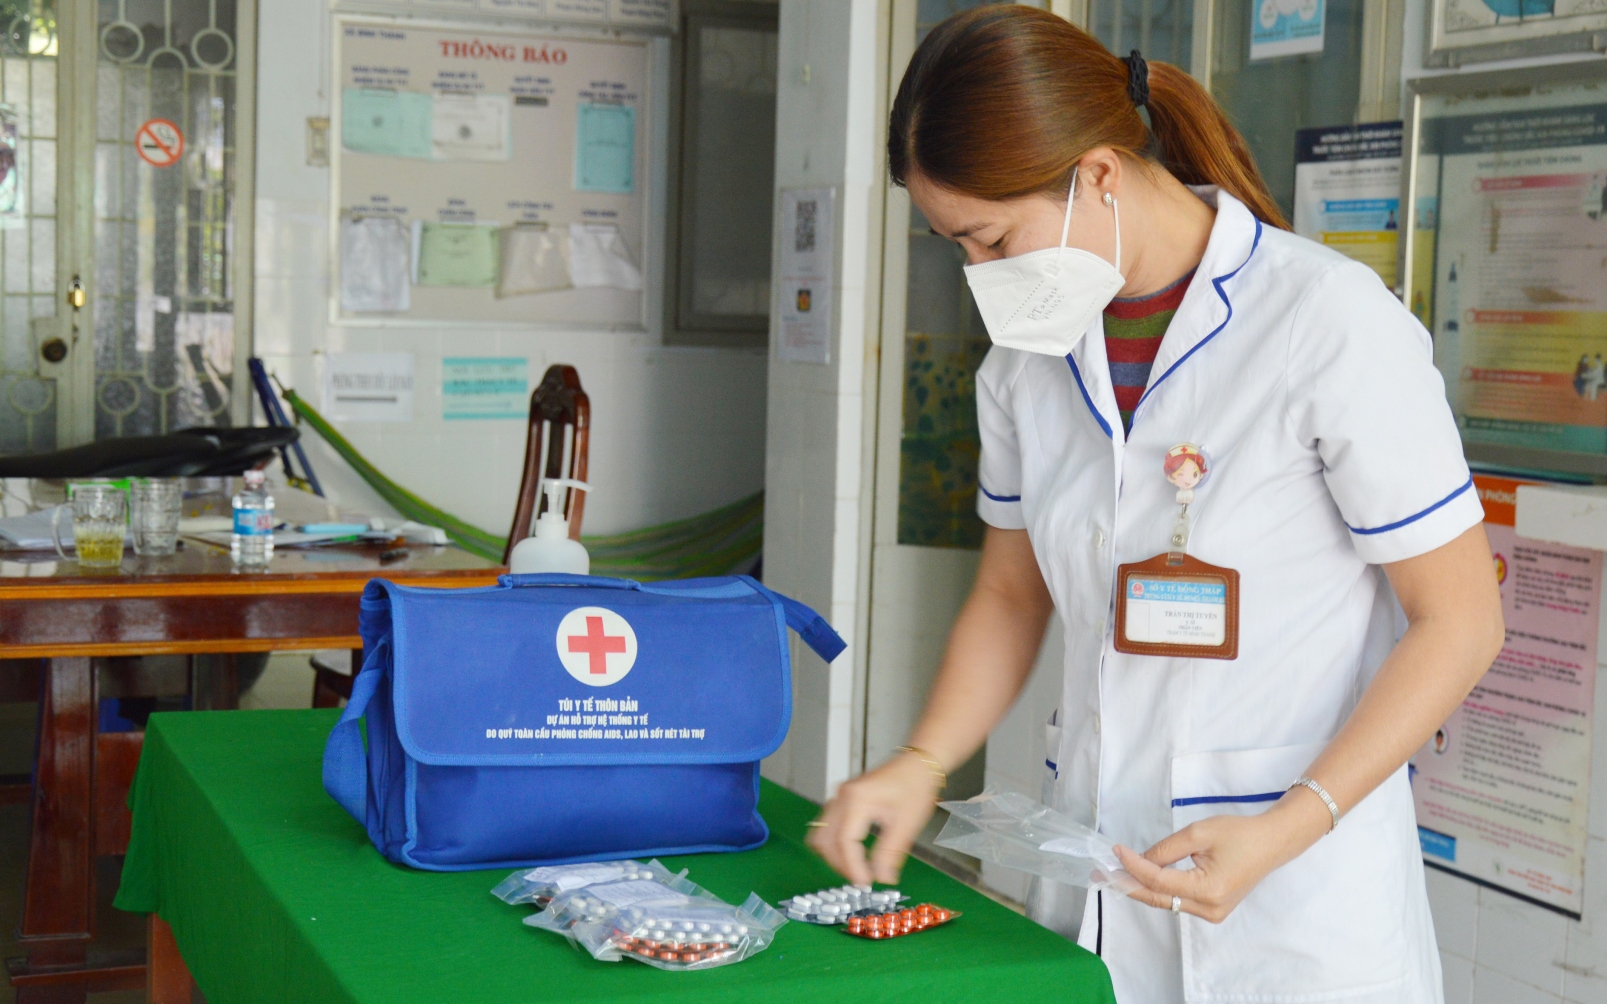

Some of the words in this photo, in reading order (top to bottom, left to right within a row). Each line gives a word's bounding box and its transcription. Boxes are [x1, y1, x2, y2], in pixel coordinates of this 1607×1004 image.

[439, 38, 516, 61] THÔNG
[523, 43, 568, 65] BÁO
[558, 698, 573, 712] TÚI
[575, 700, 581, 712] Y
[582, 696, 594, 712] TẾ
[595, 698, 618, 712] THÔN
[620, 696, 638, 712] BẢN
[546, 714, 558, 726] DỰ
[559, 714, 570, 725] ÁN
[583, 715, 597, 727] TRỢ
[598, 714, 608, 727] HỆ
[609, 713, 632, 726] THỐNG
[634, 716, 638, 726] Y
[640, 713, 648, 726] TẾ
[486, 728, 497, 739] DO
[514, 728, 534, 739] TOÀN
[552, 728, 576, 740] PHÒNG
[578, 727, 602, 740] CHỐNG
[604, 730, 623, 740] AIDS,
[624, 730, 638, 740] LAO
[640, 728, 649, 739] VÀ
[650, 727, 664, 739] SỐT
[664, 728, 678, 739] RÉT
[679, 728, 690, 739] TÀI
[691, 728, 705, 740] TRỢ
